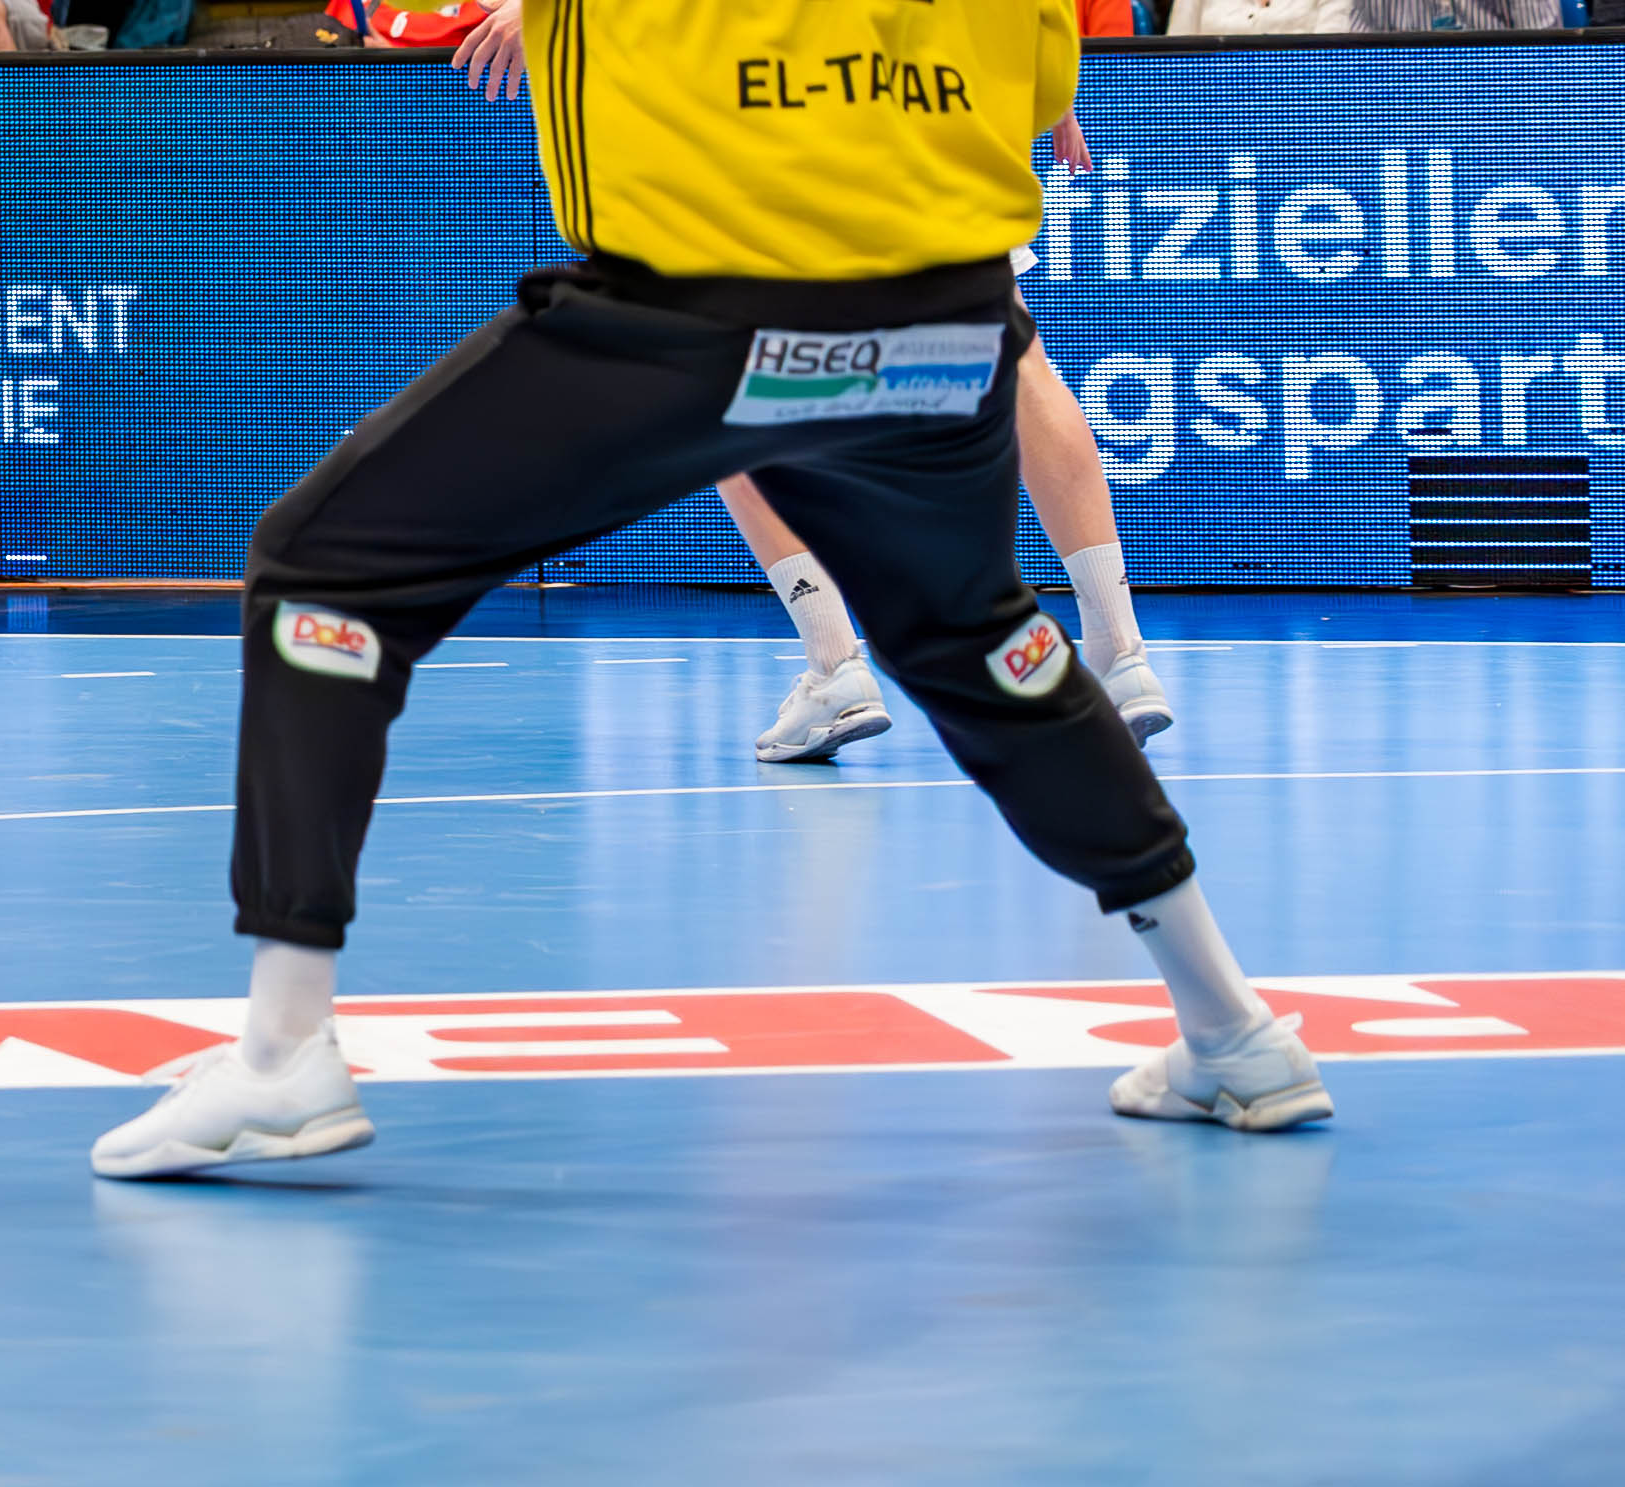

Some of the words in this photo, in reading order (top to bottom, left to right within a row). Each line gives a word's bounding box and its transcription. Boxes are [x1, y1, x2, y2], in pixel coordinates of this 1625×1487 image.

[753, 337, 882, 374] HSEQ
[292, 612, 367, 655] Dole
[1003, 624, 1056, 678] Dole
